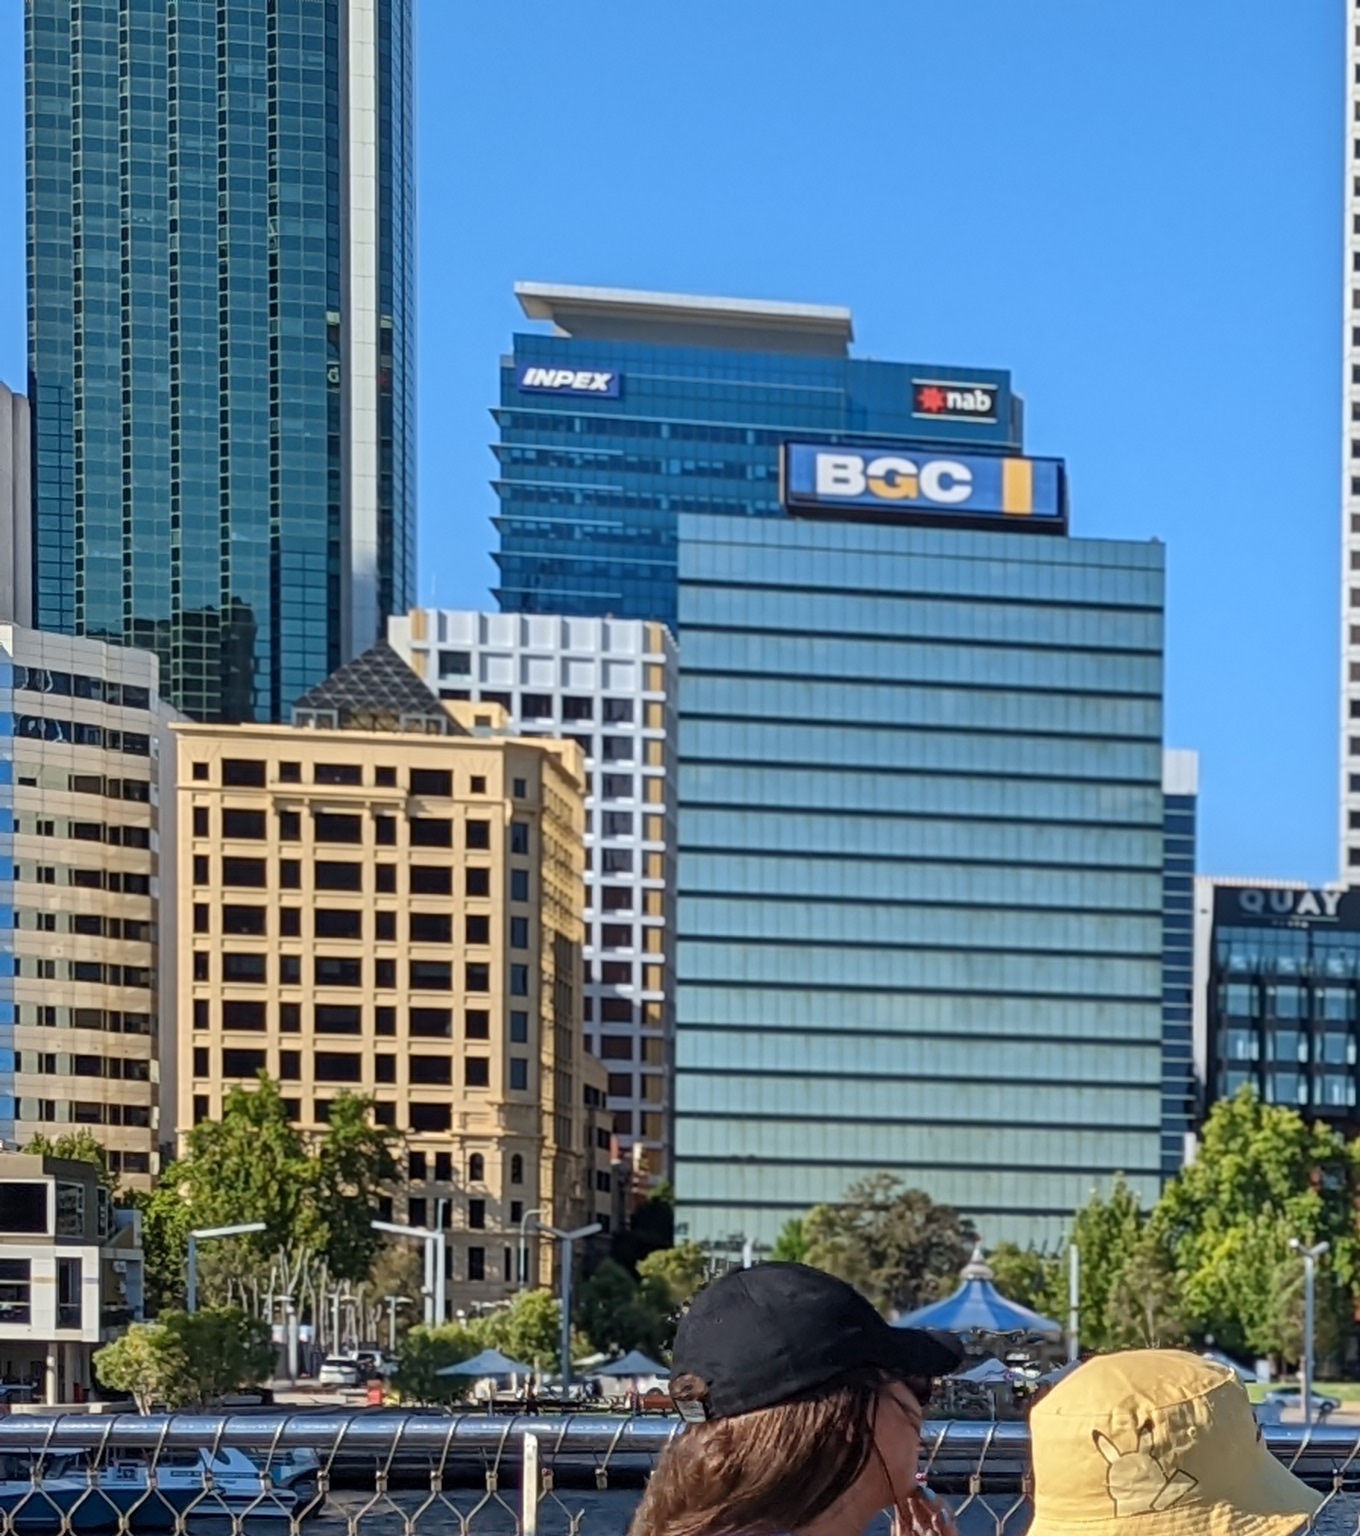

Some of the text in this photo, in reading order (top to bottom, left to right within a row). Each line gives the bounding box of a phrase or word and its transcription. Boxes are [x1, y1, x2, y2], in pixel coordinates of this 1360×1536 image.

[522, 367, 612, 391] INPEX
[945, 388, 992, 412] nab
[815, 453, 973, 503] BGC
[1239, 888, 1342, 915] QUAY
